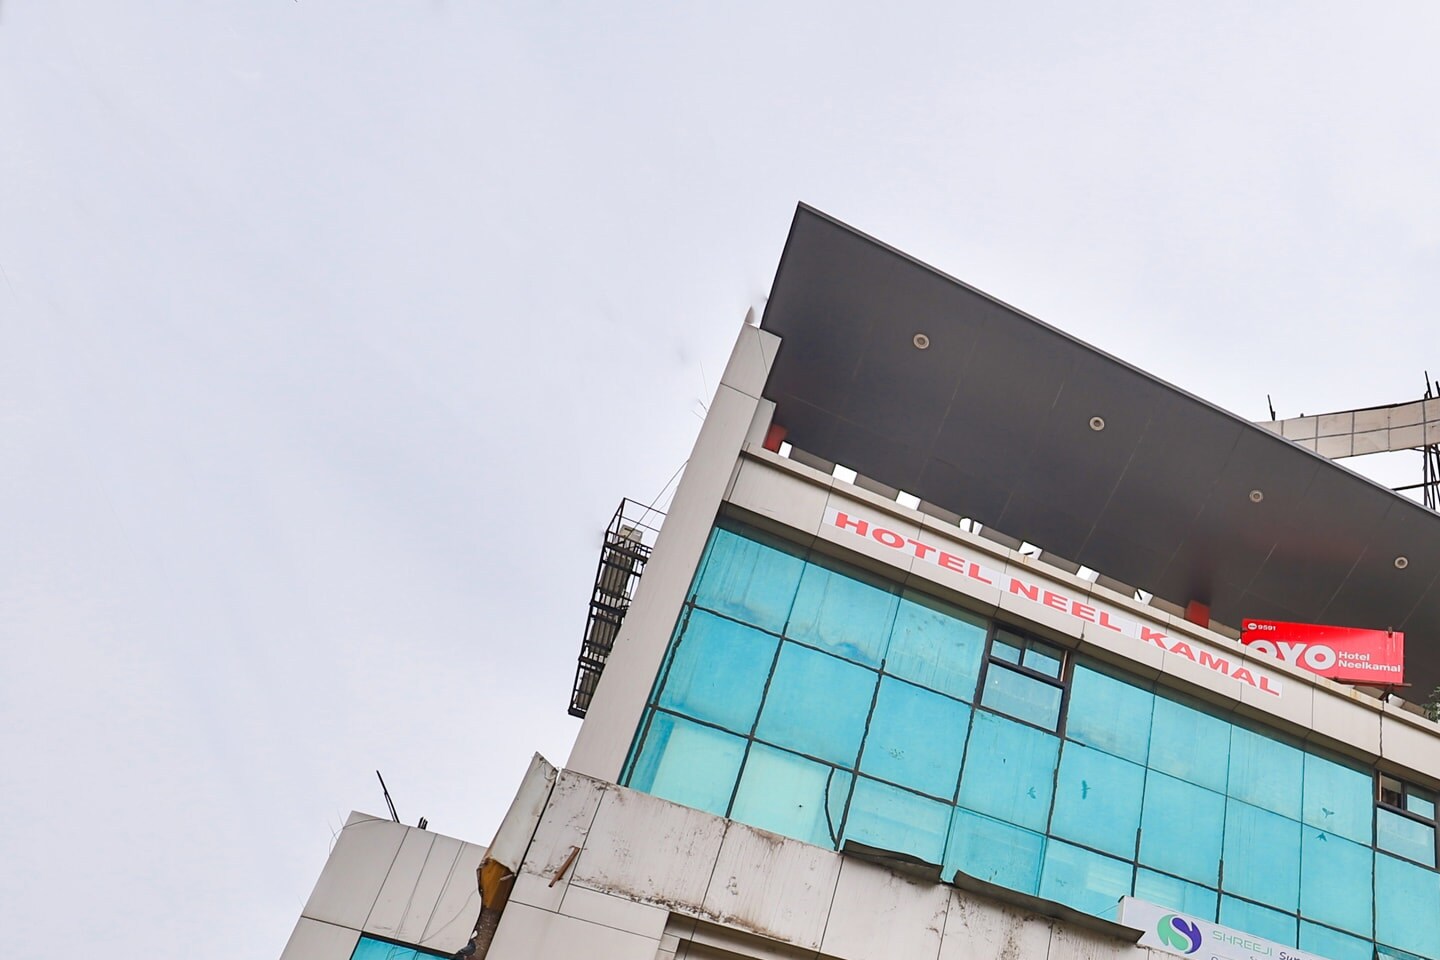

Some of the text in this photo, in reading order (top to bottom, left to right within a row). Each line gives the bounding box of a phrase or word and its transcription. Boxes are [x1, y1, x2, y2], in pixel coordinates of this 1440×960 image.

[834, 511, 1281, 696] HOTEL NEEL KAMAL
[1338, 651, 1370, 661] Hotel
[1338, 660, 1401, 672] Neelkamal
[1212, 930, 1273, 956] SHREEJI
